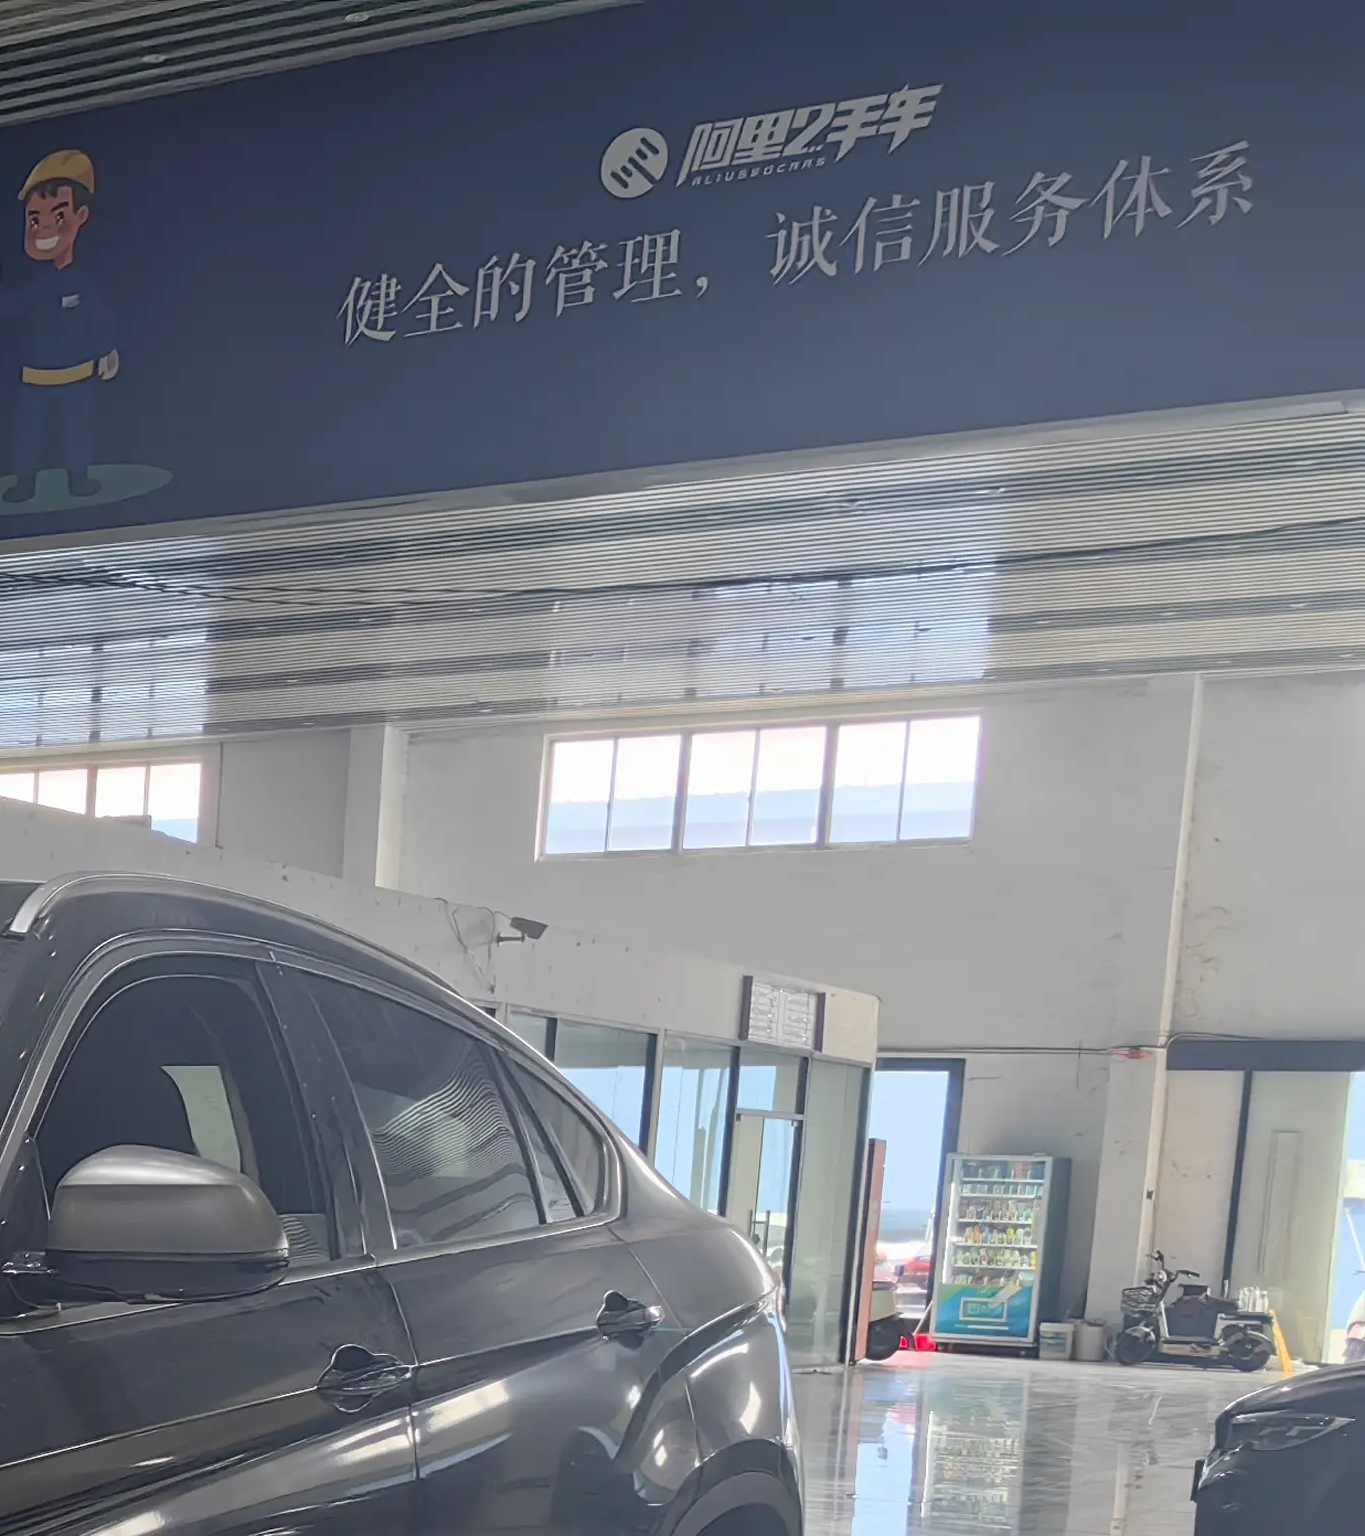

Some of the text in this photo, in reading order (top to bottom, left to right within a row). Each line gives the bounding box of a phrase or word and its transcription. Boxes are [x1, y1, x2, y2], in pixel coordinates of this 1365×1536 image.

[676, 83, 944, 188] 阿里2手车
[336, 139, 1257, 348] 健全的管理，诚信服务体系
